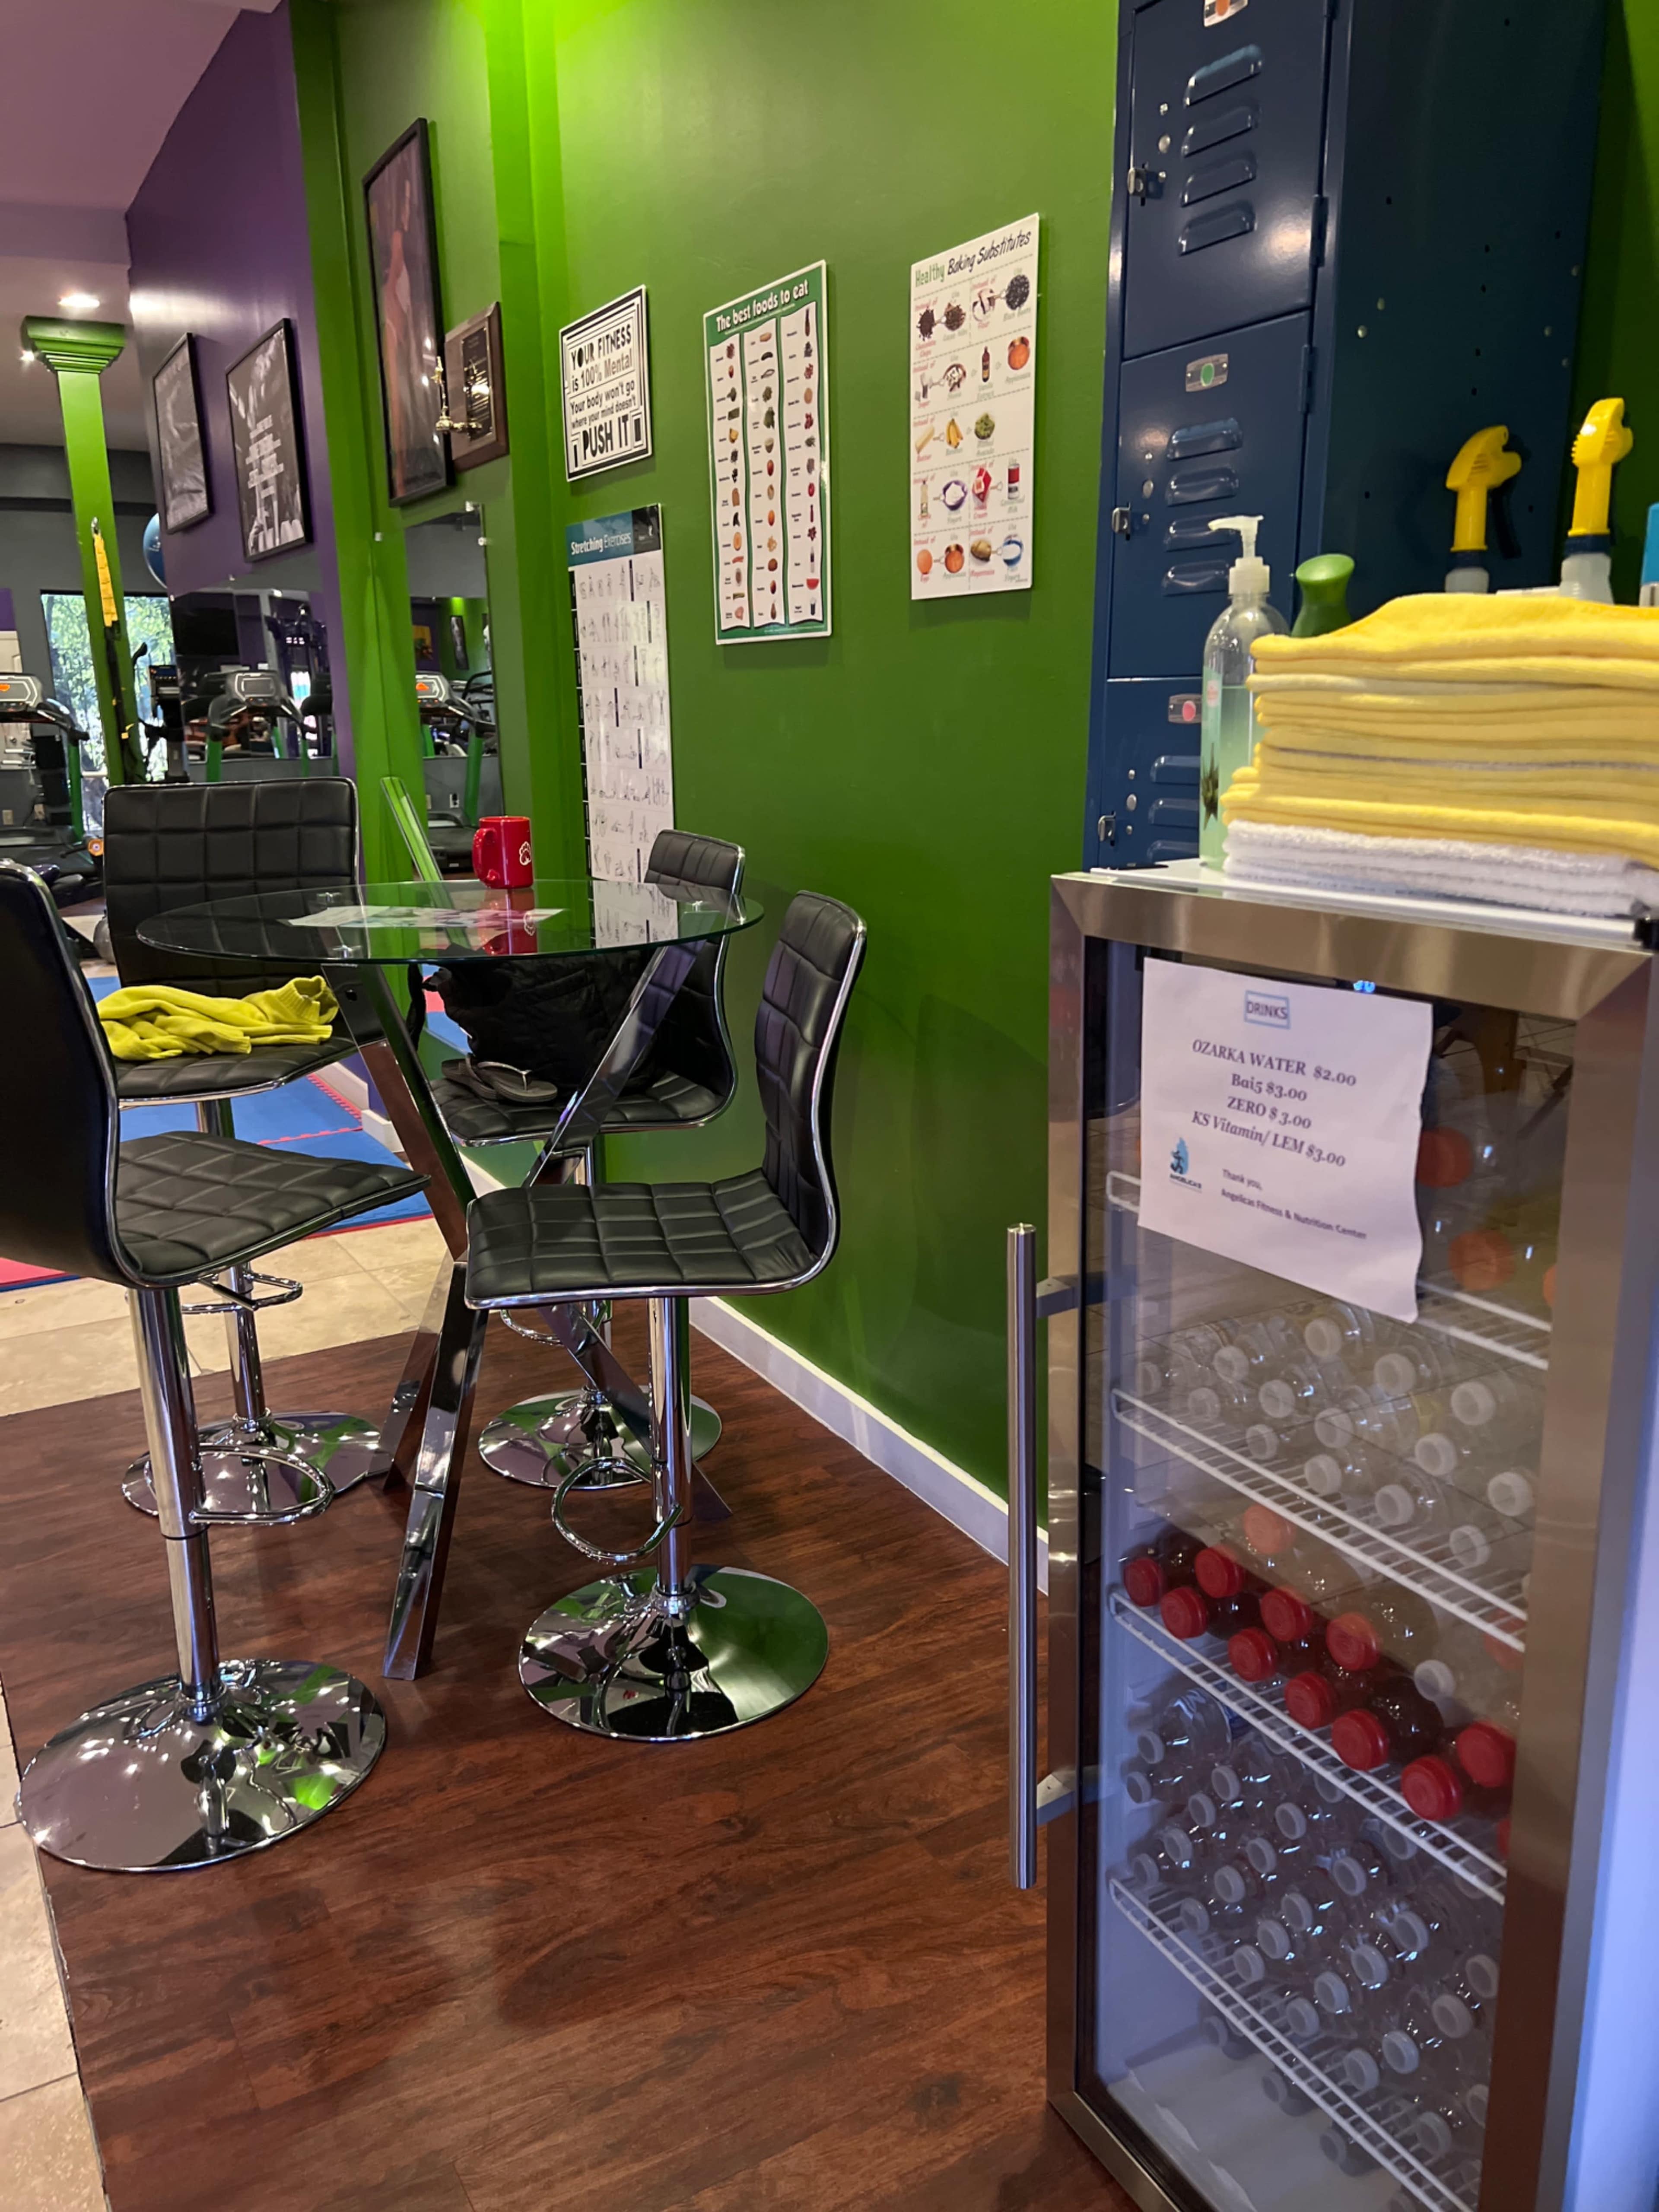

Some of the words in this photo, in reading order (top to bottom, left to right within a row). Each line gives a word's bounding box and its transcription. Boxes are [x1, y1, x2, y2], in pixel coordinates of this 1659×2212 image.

[915, 263, 945, 287] Healthy
[947, 254, 976, 275] Baking
[977, 229, 1031, 265] Substitutes
[716, 315, 731, 332] The
[732, 305, 750, 325] best
[753, 292, 778, 316] foods
[781, 289, 790, 304] to
[793, 280, 808, 299] eat
[571, 342, 594, 370] YOUR
[597, 324, 632, 359] FITNESS
[572, 376, 579, 391] is
[581, 360, 602, 388] 100%
[604, 348, 632, 378] Mental
[570, 400, 585, 416] Your
[587, 391, 603, 409] body
[605, 382, 624, 400] won't
[626, 379, 635, 396] go
[572, 414, 588, 429] where
[588, 411, 600, 427] your
[601, 403, 614, 419] mind
[615, 394, 636, 413] doesn't
[582, 420, 613, 460] PUSH
[618, 414, 629, 448] IT
[571, 536, 603, 555] Stretching
[604, 532, 632, 548] Exercises
[1246, 1001, 1288, 1020] DRINKS
[1192, 1039, 1245, 1065] OZARKA
[1249, 1052, 1306, 1076] WATER
[1313, 1065, 1357, 1087] $2.00
[1227, 1096, 1266, 1117] ZERO
[1231, 1073, 1262, 1094] Bai5
[1266, 1081, 1307, 1101] $3.00
[1192, 1111, 1211, 1127] KS
[1213, 1116, 1271, 1147] Vitamin/
[1272, 1134, 1305, 1154] LEM
[1306, 1144, 1346, 1167] $3.00
[1223, 1168, 1245, 1183] Thank
[1221, 1189, 1255, 1207] Angelicas
[1257, 1200, 1283, 1217] Fitness
[1285, 1210, 1291, 1219] &
[1294, 1212, 1333, 1230] Nutrition
[1335, 1224, 1367, 1239] Center
